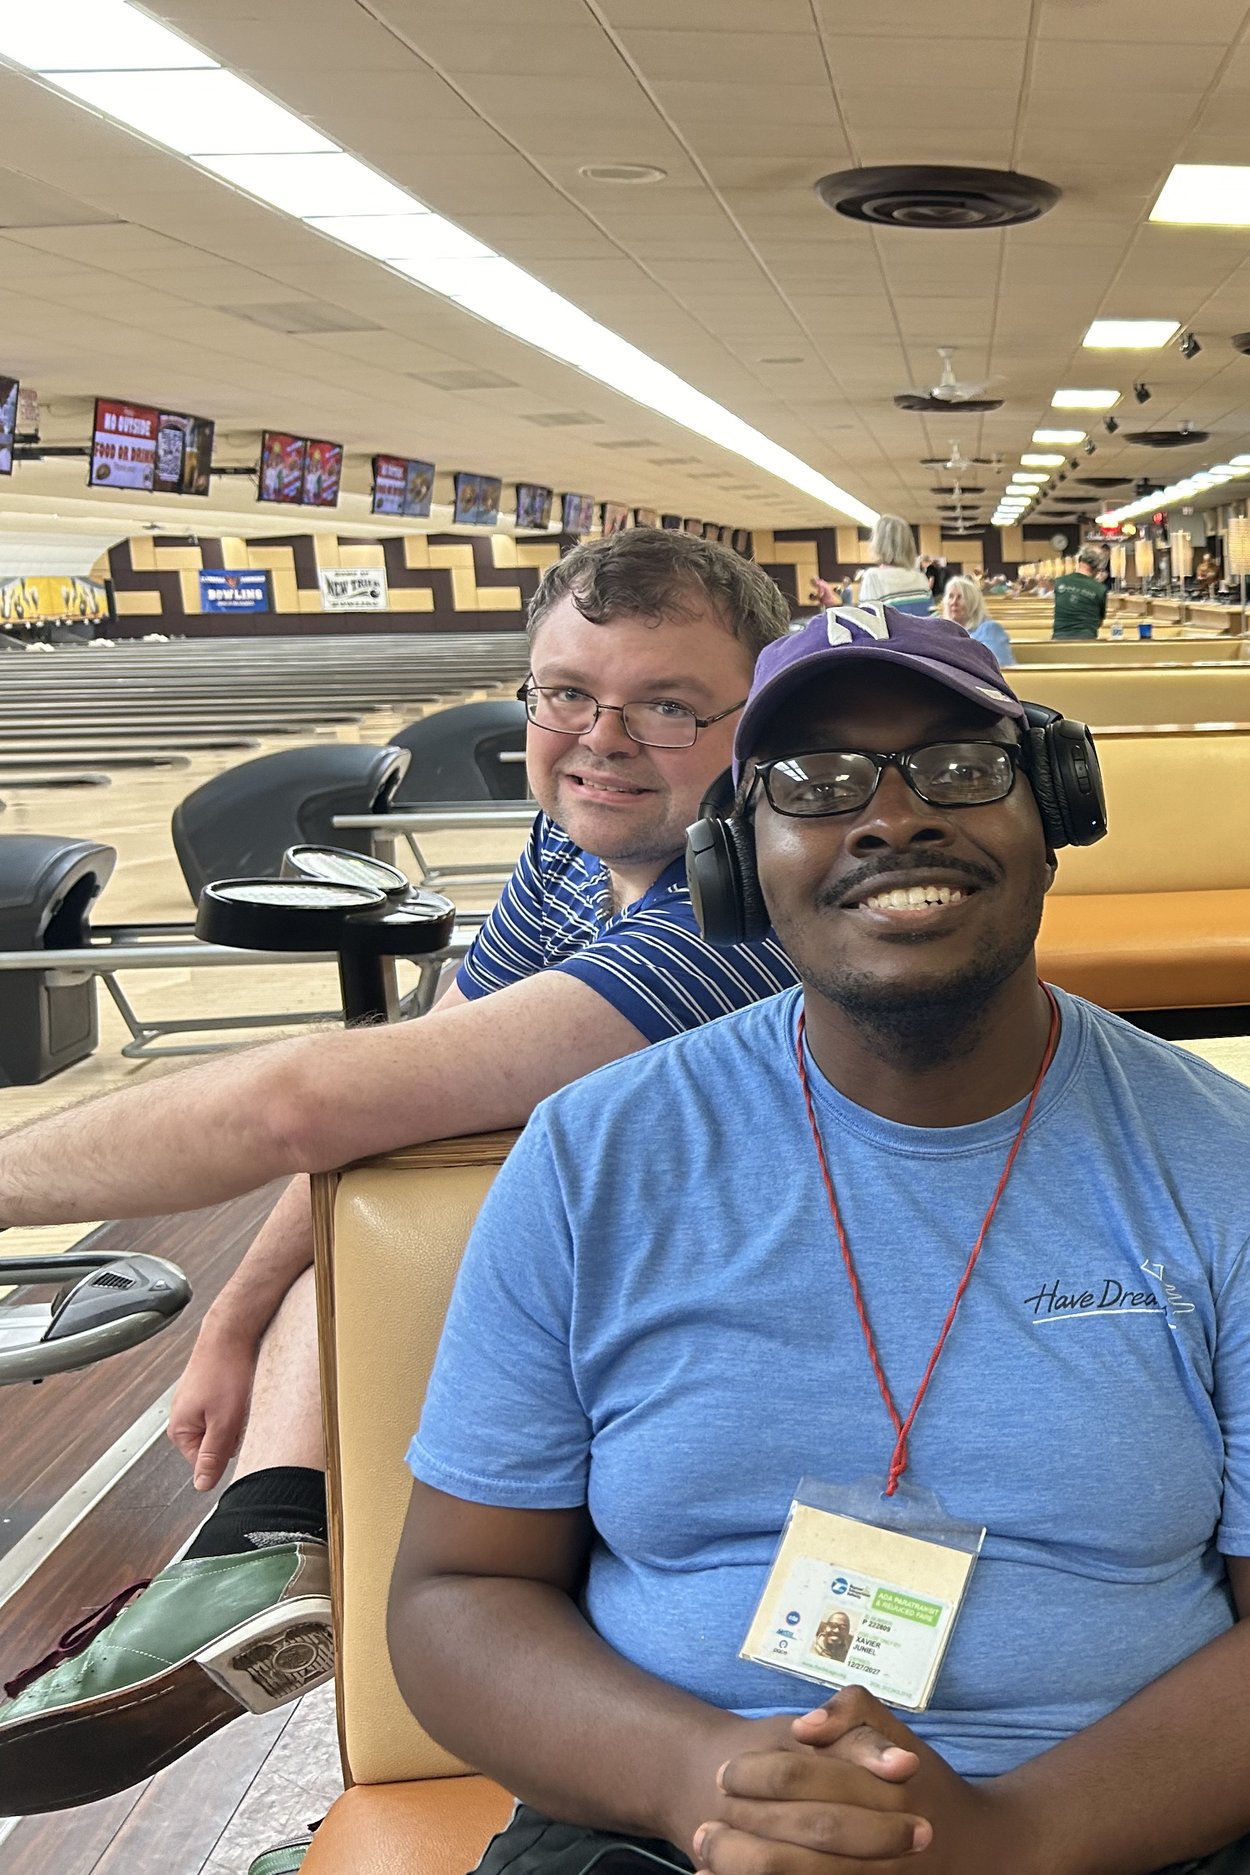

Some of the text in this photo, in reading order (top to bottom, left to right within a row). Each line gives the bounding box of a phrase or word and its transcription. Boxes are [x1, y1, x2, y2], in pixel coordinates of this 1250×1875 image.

[95, 441, 116, 459] FOOD
[118, 444, 129, 461] OR
[324, 574, 349, 597] NEW
[207, 588, 263, 601] BOWLING
[826, 600, 890, 646] N
[1024, 1279, 1095, 1314] Have
[878, 1592, 893, 1602] ADA
[881, 1602, 915, 1616] REDUCED
[915, 1612, 933, 1622] FARE
[852, 1644, 877, 1656] JUNIEL
[856, 1636, 881, 1649] XAVIER
[847, 1661, 880, 1676] 12/27/2027
